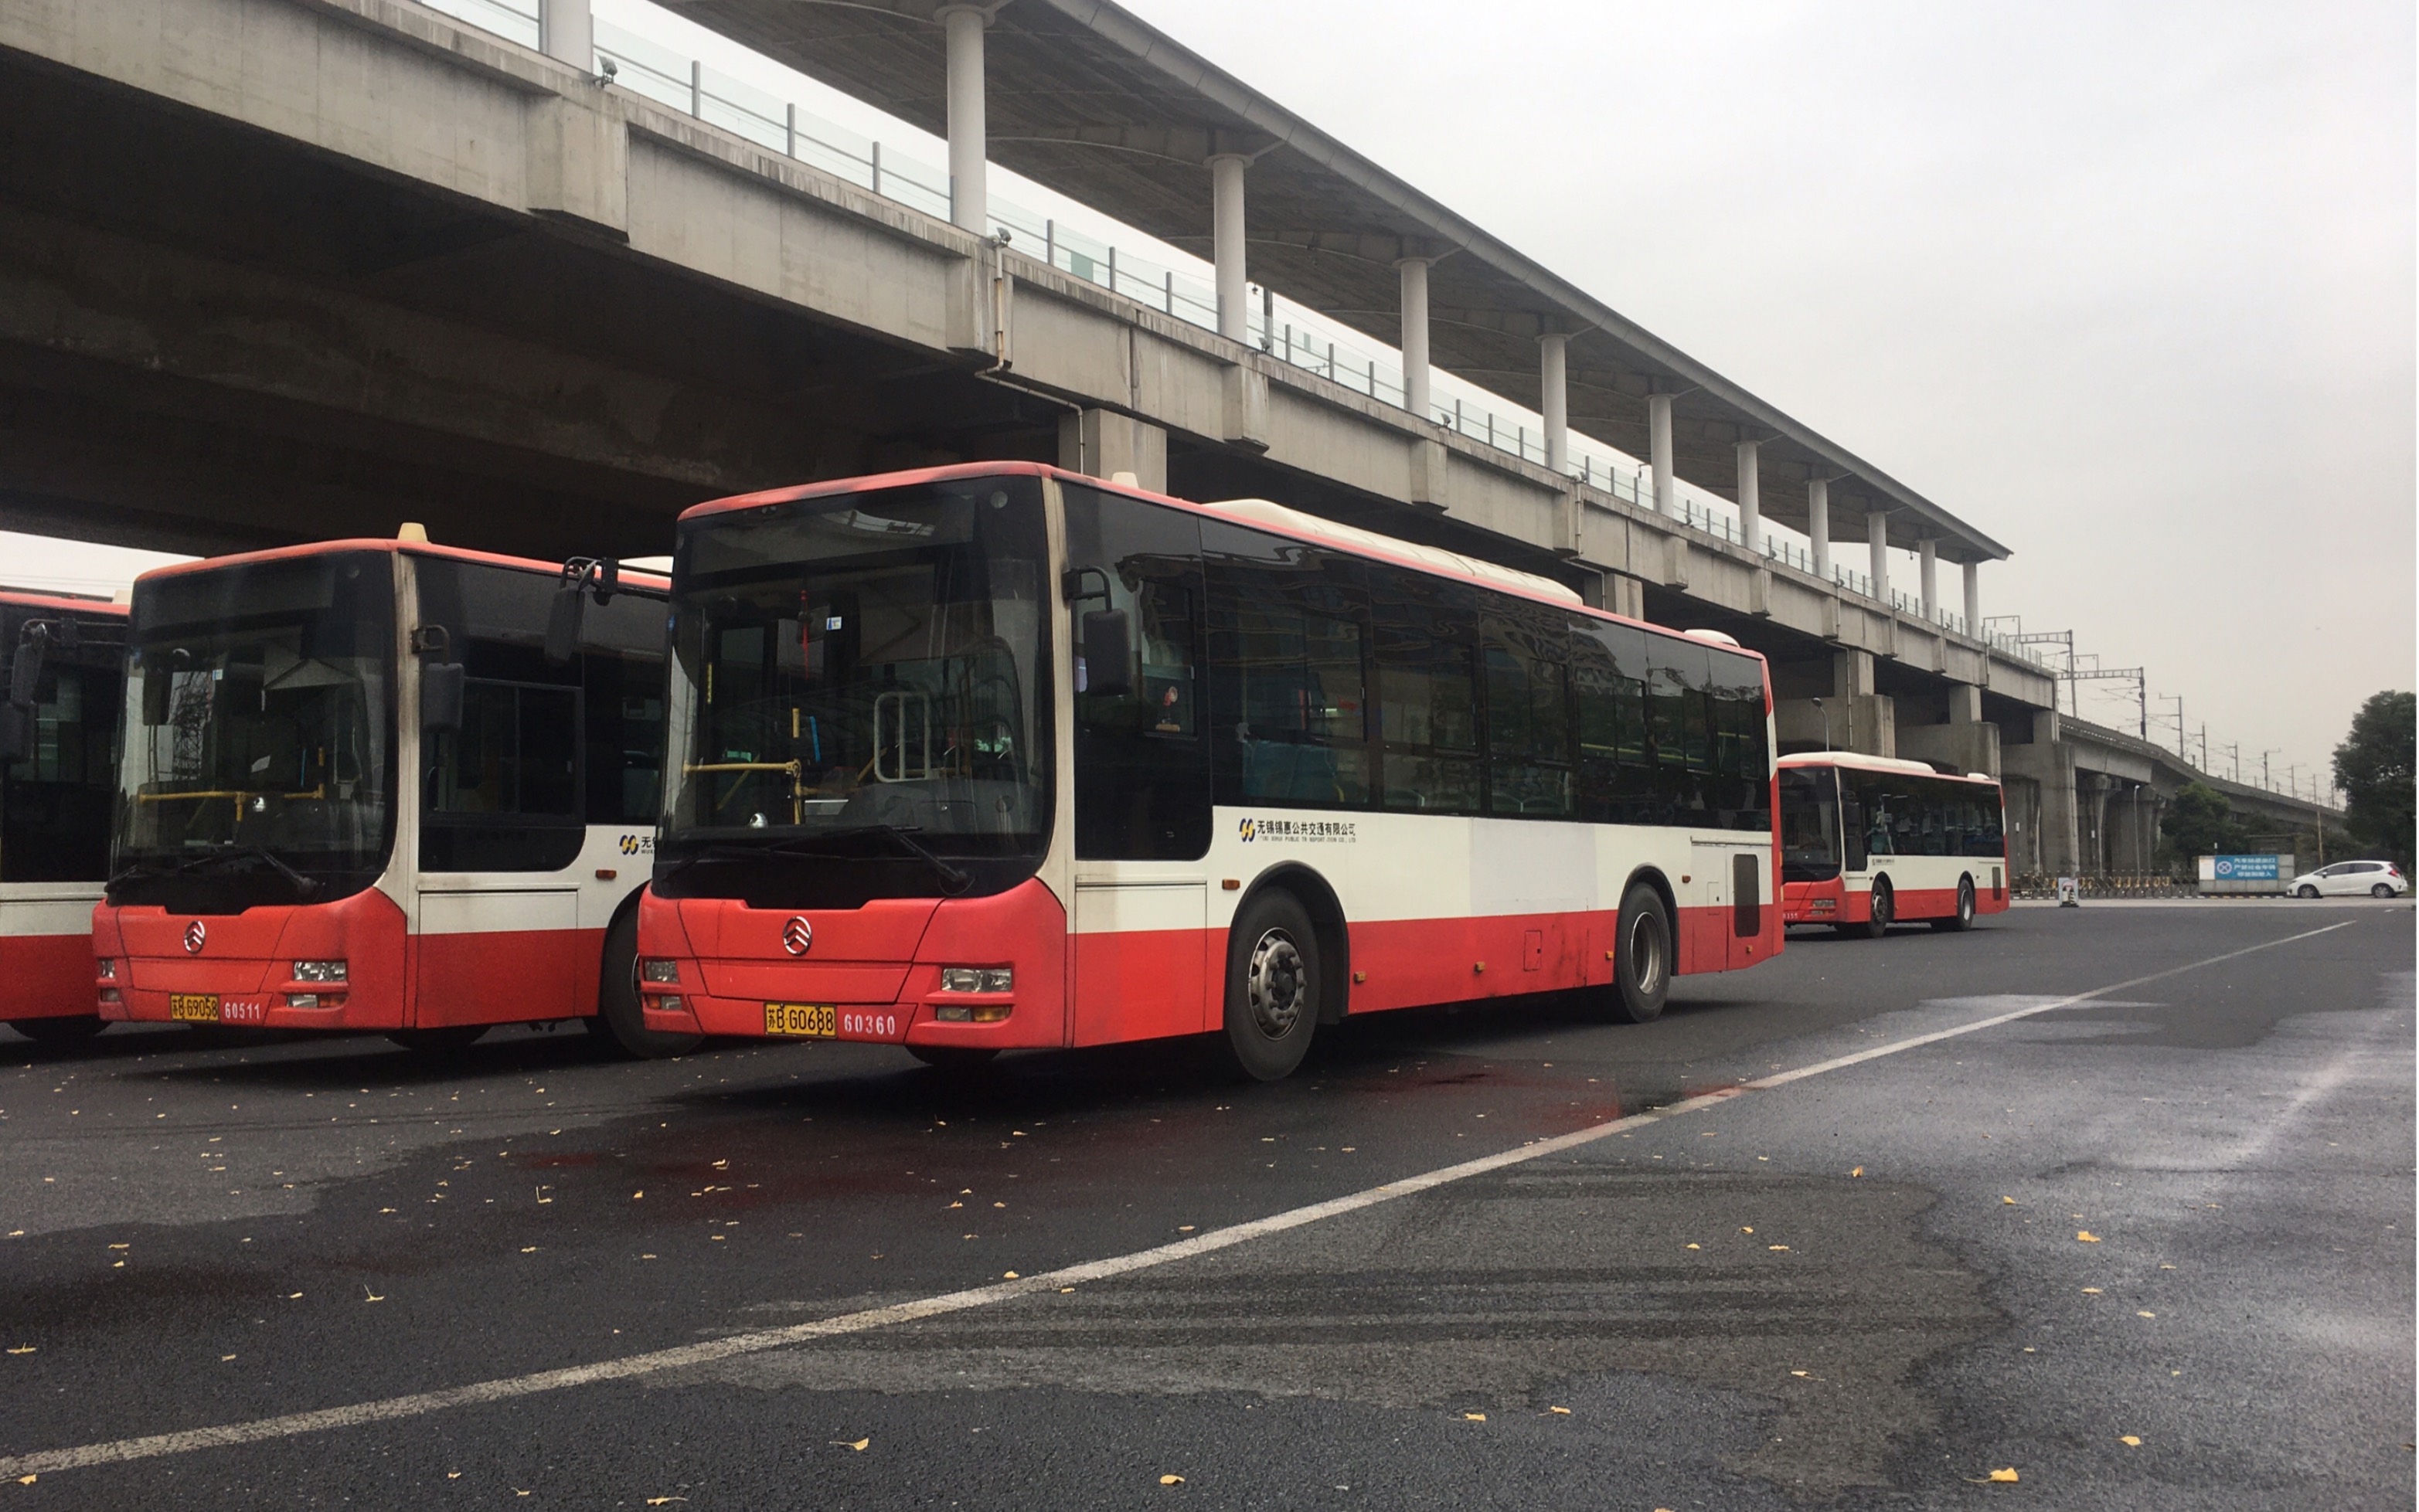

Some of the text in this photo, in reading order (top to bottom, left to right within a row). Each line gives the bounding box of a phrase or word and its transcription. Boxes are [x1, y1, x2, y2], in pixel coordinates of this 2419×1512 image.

[1257, 821, 1355, 836] 无锡锡惠公共交通有限公司
[225, 1002, 260, 1019] 60511
[844, 1014, 895, 1035] 60360
